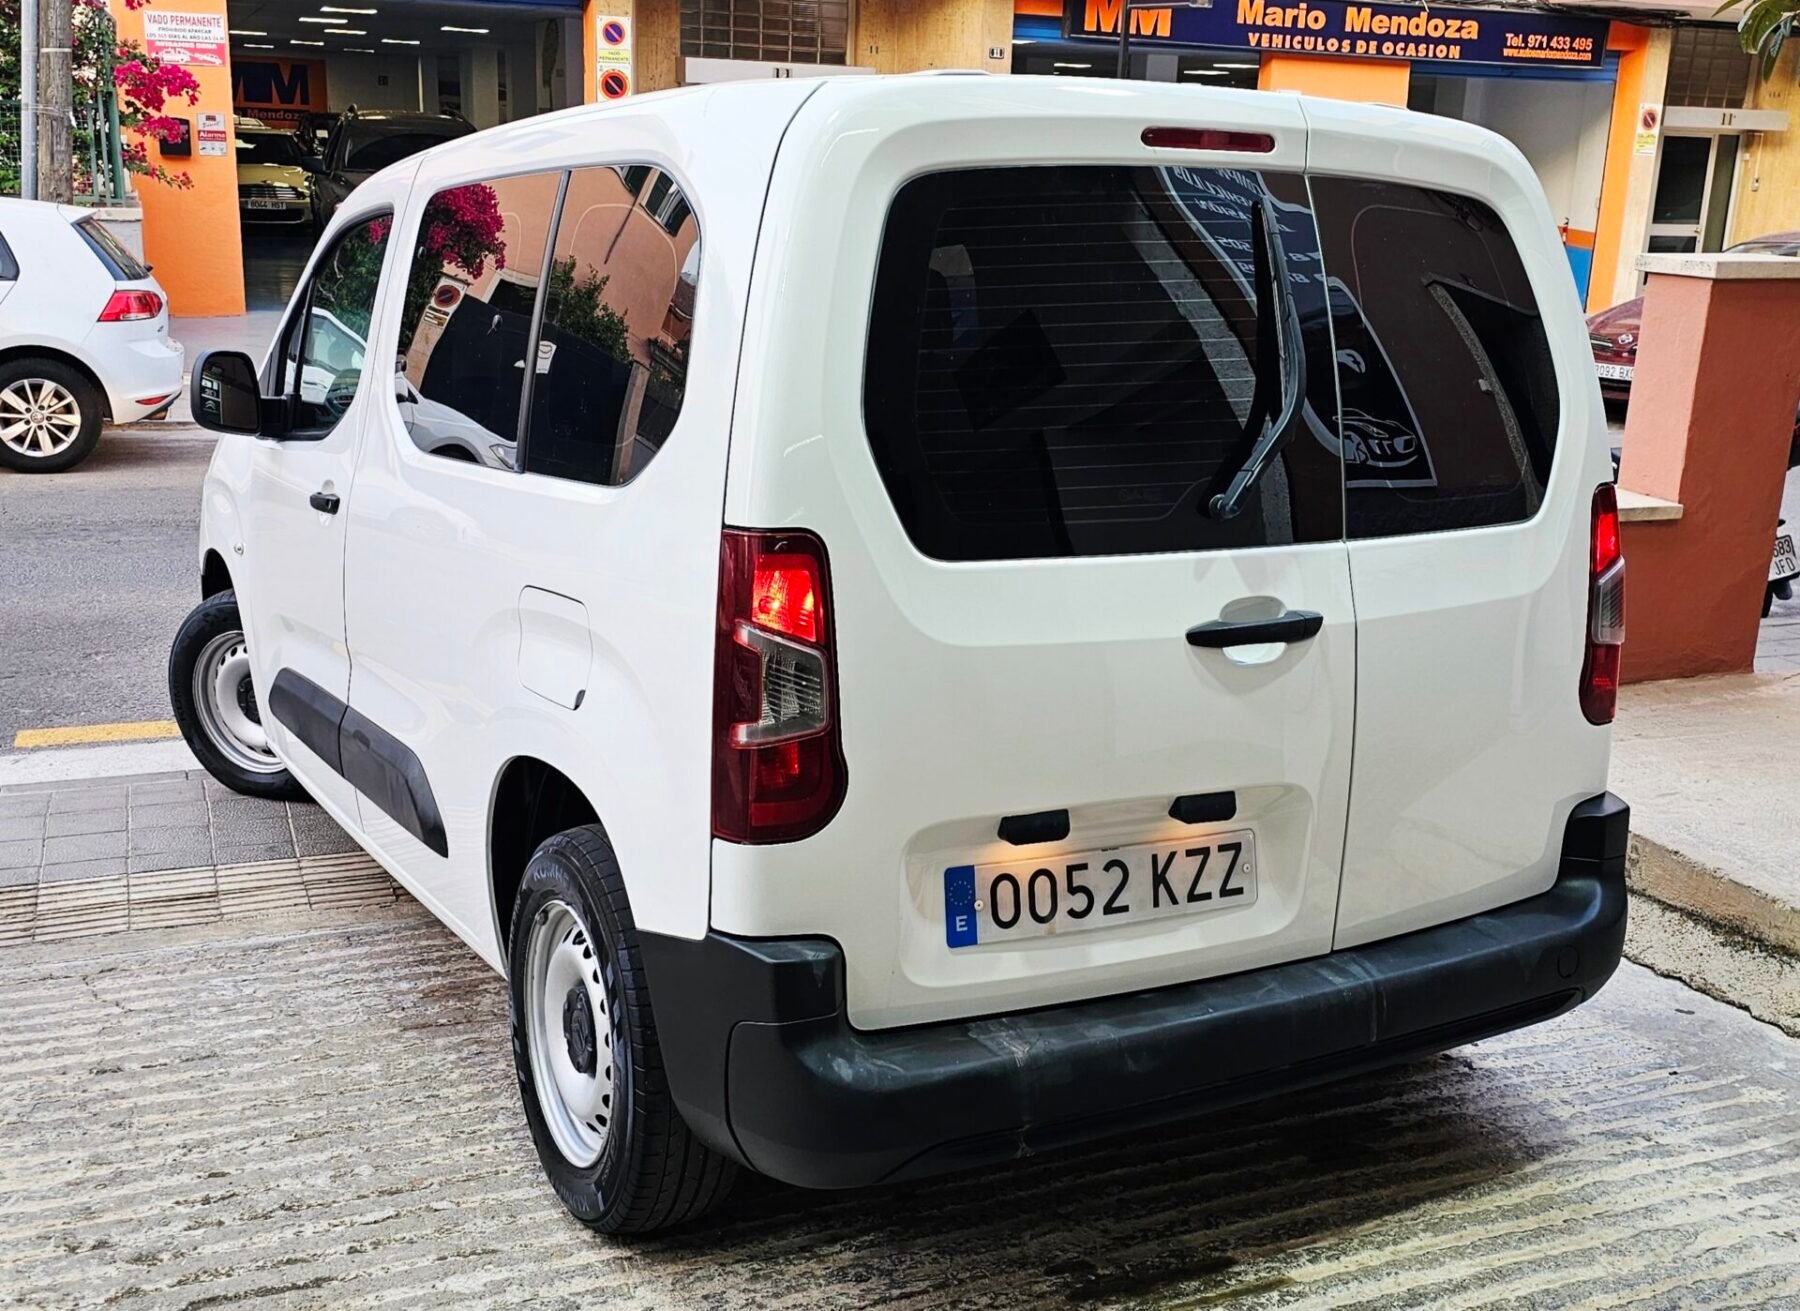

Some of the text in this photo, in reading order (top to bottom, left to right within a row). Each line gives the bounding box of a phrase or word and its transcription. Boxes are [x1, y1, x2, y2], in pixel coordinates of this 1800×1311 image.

[147, 13, 223, 28] VADO PERMANENTE
[1236, 0, 1479, 40] Mario Mendoza
[1248, 31, 1461, 59] VEHICULOS DE OCASION
[1505, 33, 1594, 51] Tel. 971 433 495
[989, 841, 1245, 929] 0052 KZZ
[956, 915, 968, 932] E
